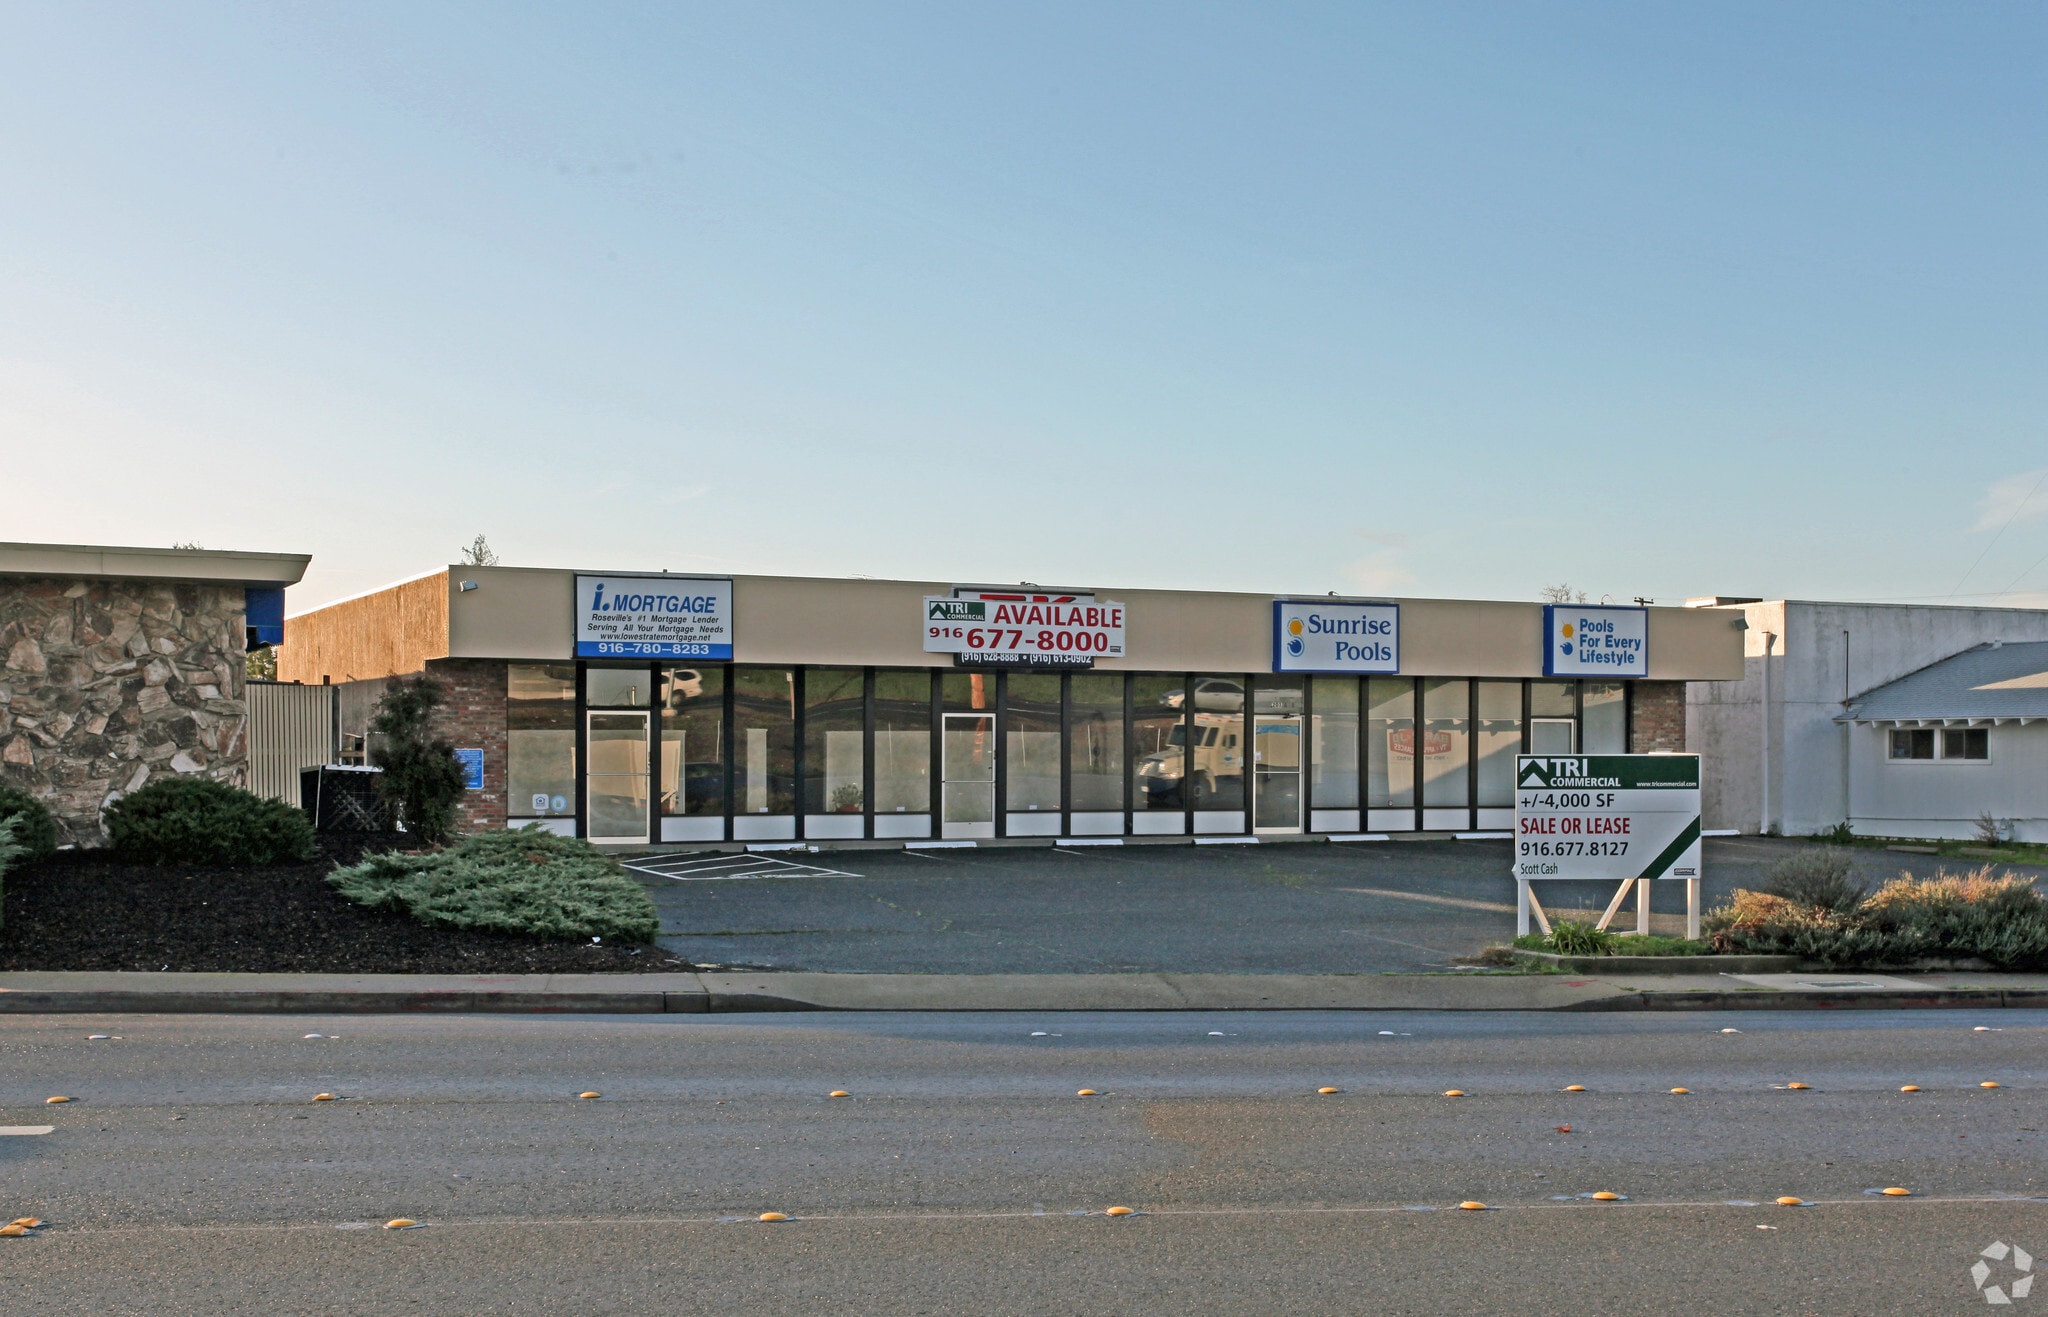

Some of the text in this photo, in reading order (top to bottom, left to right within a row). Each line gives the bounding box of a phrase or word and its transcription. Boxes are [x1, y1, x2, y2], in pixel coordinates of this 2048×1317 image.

[613, 594, 717, 613] MORTGAGE
[947, 602, 968, 614] TRI
[591, 614, 632, 622] Roseville's
[651, 615, 687, 624] Mortgage
[692, 616, 719, 624] Lender
[946, 613, 985, 621] COMMERCIAL
[993, 604, 1122, 628] AVAILABLE
[587, 623, 618, 632] Serving
[637, 624, 654, 632] Your
[658, 625, 694, 634] Mortgage
[700, 625, 724, 633] Needs
[1308, 614, 1391, 635] Sunrise
[1580, 618, 1614, 632] Pools
[600, 633, 711, 642] www.lowestratemortgage.net
[929, 626, 1108, 652] 916 677-8000
[1580, 634, 1642, 651] For Every
[598, 643, 710, 655] 916-780-8283
[1335, 641, 1391, 661] Pools
[1580, 649, 1635, 666] Lifestyle
[1550, 758, 1588, 777] TRI
[1550, 777, 1621, 787] COMMERCIAL
[1521, 793, 1615, 810] +/-4,000 SF
[1521, 817, 1631, 835] SALE OR LEASE
[1521, 841, 1629, 856] 916.677.8127
[1520, 863, 1558, 875] Scott Cash
